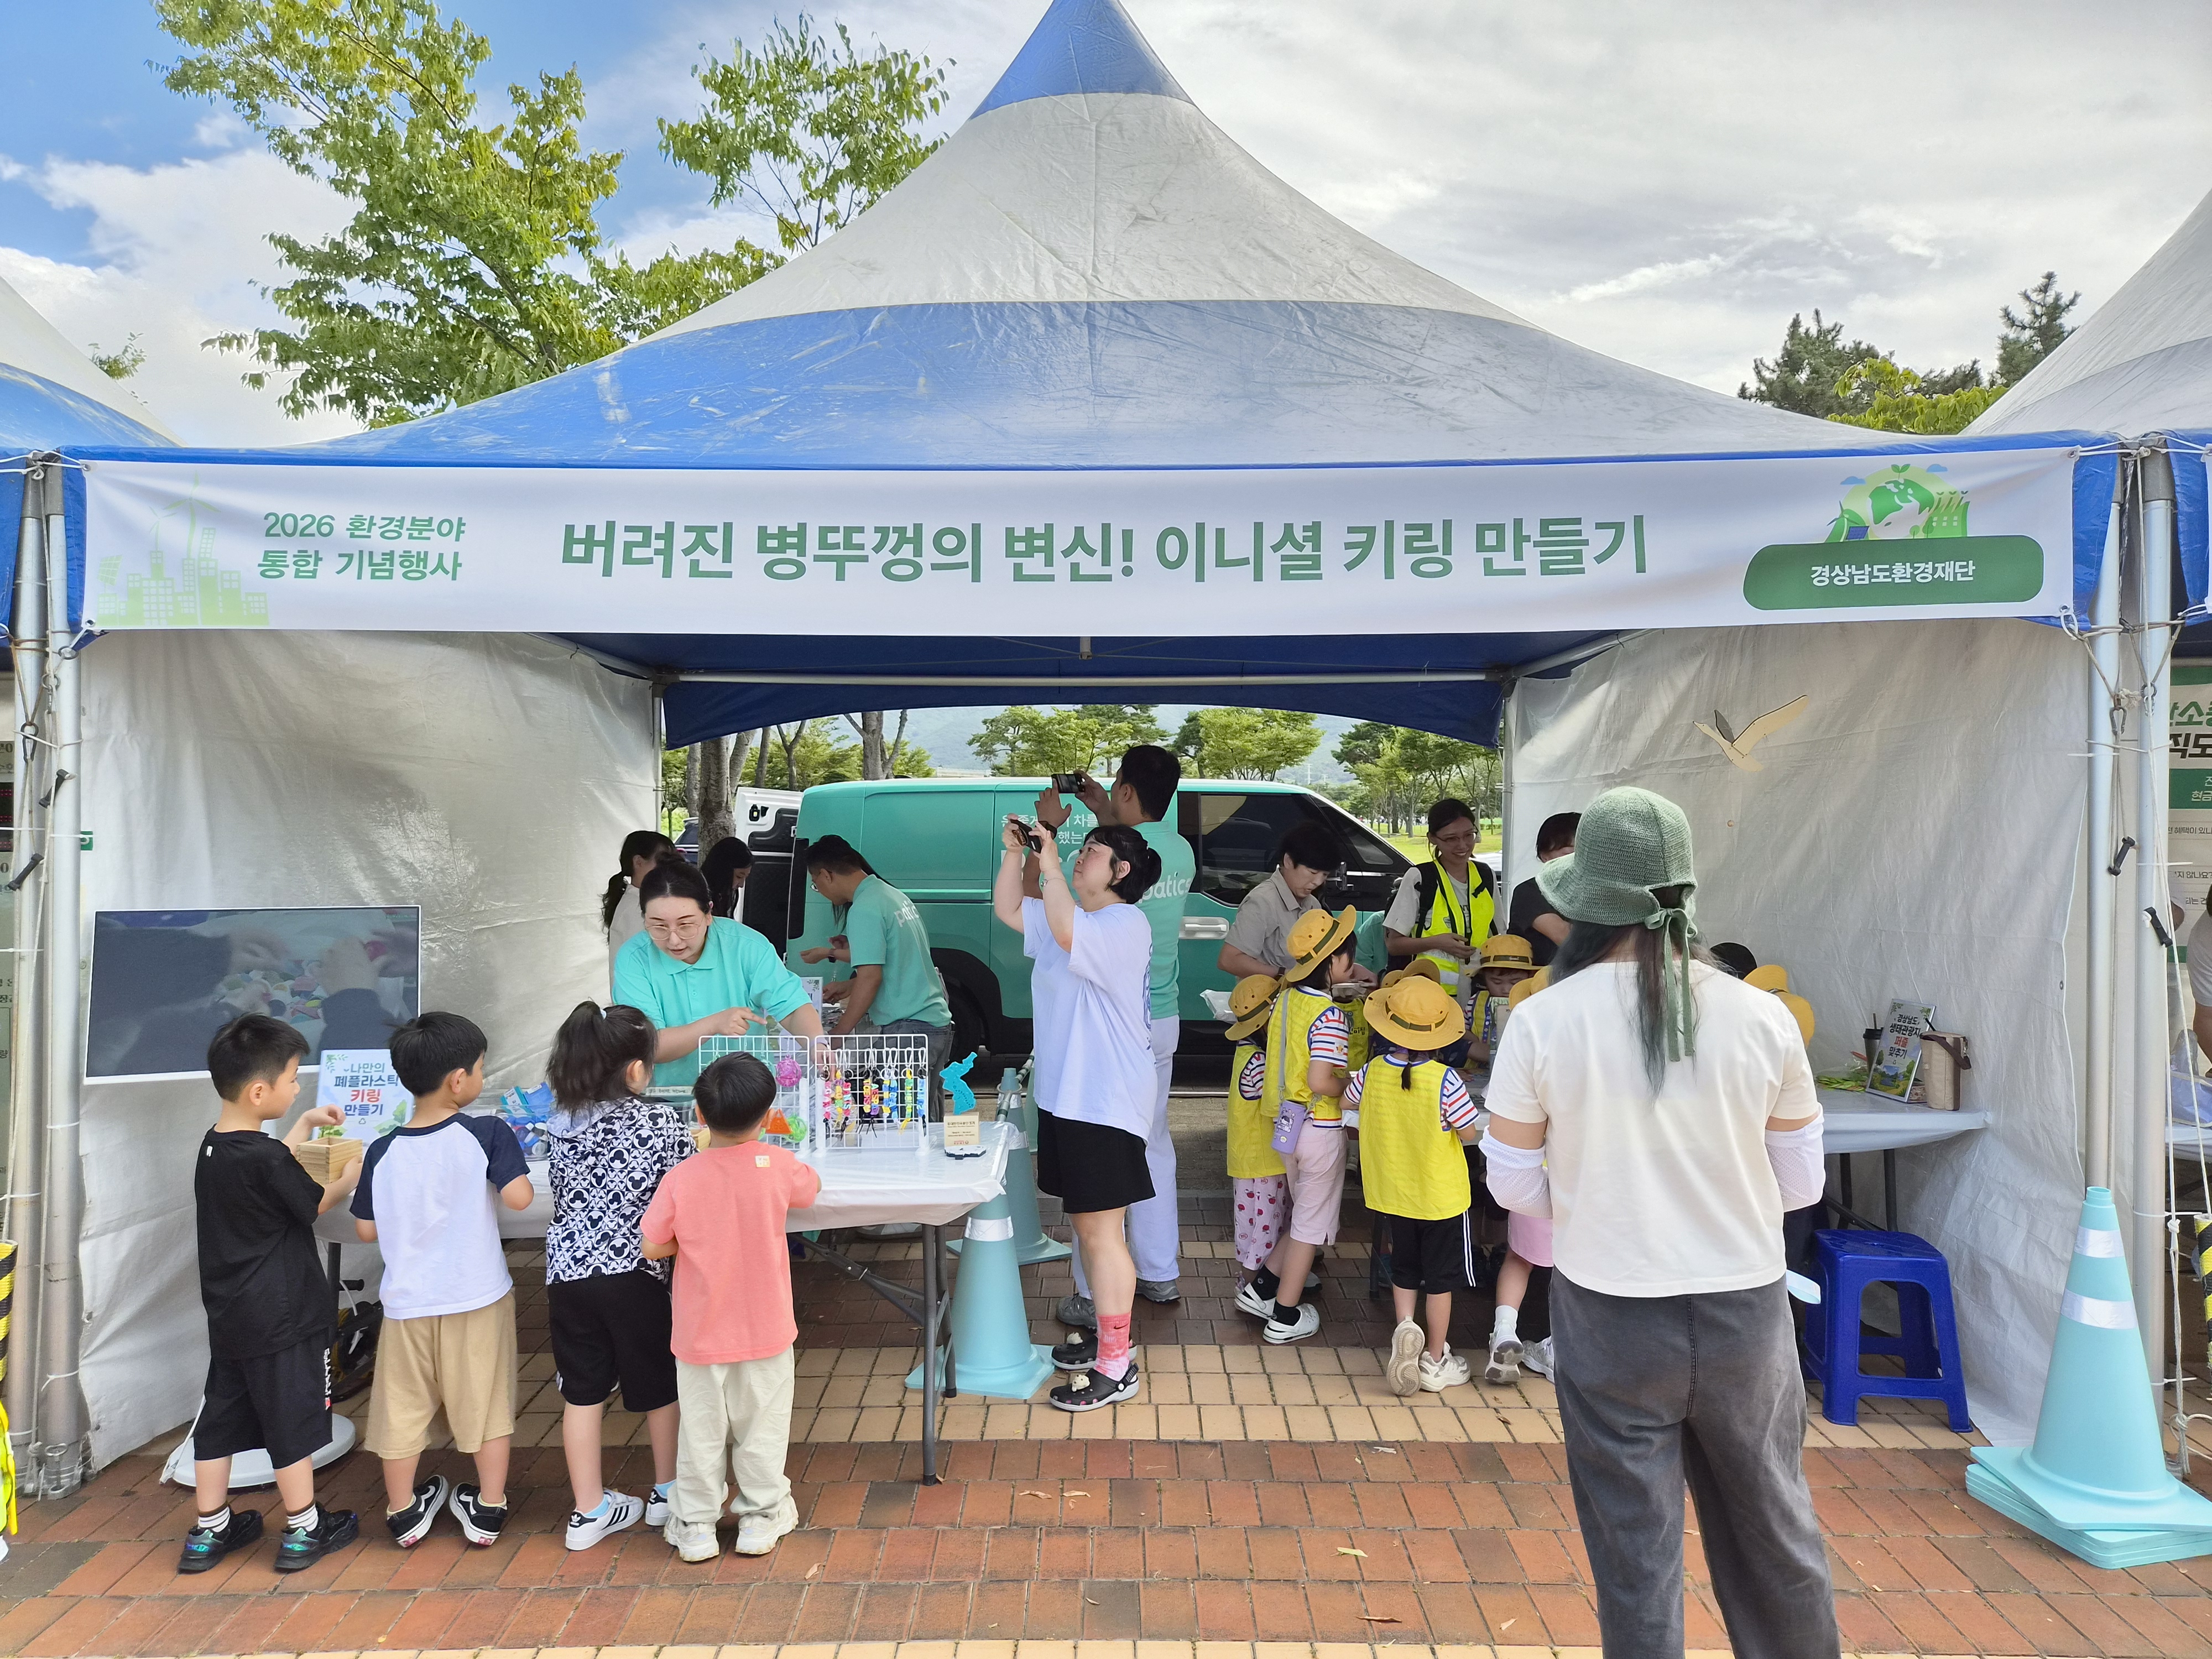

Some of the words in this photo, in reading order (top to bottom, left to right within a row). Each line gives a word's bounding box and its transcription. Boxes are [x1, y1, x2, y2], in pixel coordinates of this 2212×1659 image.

[263, 512, 335, 538] 2026
[346, 514, 466, 541] 환경분야
[561, 520, 733, 578] 버려진
[756, 522, 982, 583] 병뚜껑의
[1004, 522, 1134, 583] 변신!
[1156, 520, 1323, 582] 이니셜
[1343, 519, 1453, 580] 키링
[1475, 515, 1647, 576] 만들기
[258, 550, 323, 579] 통합
[335, 550, 462, 581] 기념행사
[1811, 560, 1976, 586] 경상남도환경재단
[1058, 831, 1088, 844] 했는
[1897, 1014, 1918, 1025] 경상남도
[1890, 1023, 1921, 1037] 생태관광지
[1894, 1036, 1908, 1048] 퍼즐
[1888, 1046, 1907, 1059] 맞추기
[351, 1062, 385, 1073] 나만의
[334, 1074, 399, 1088] 폐플라스틱
[351, 1089, 381, 1103] 키링
[345, 1104, 383, 1116] 만들기
